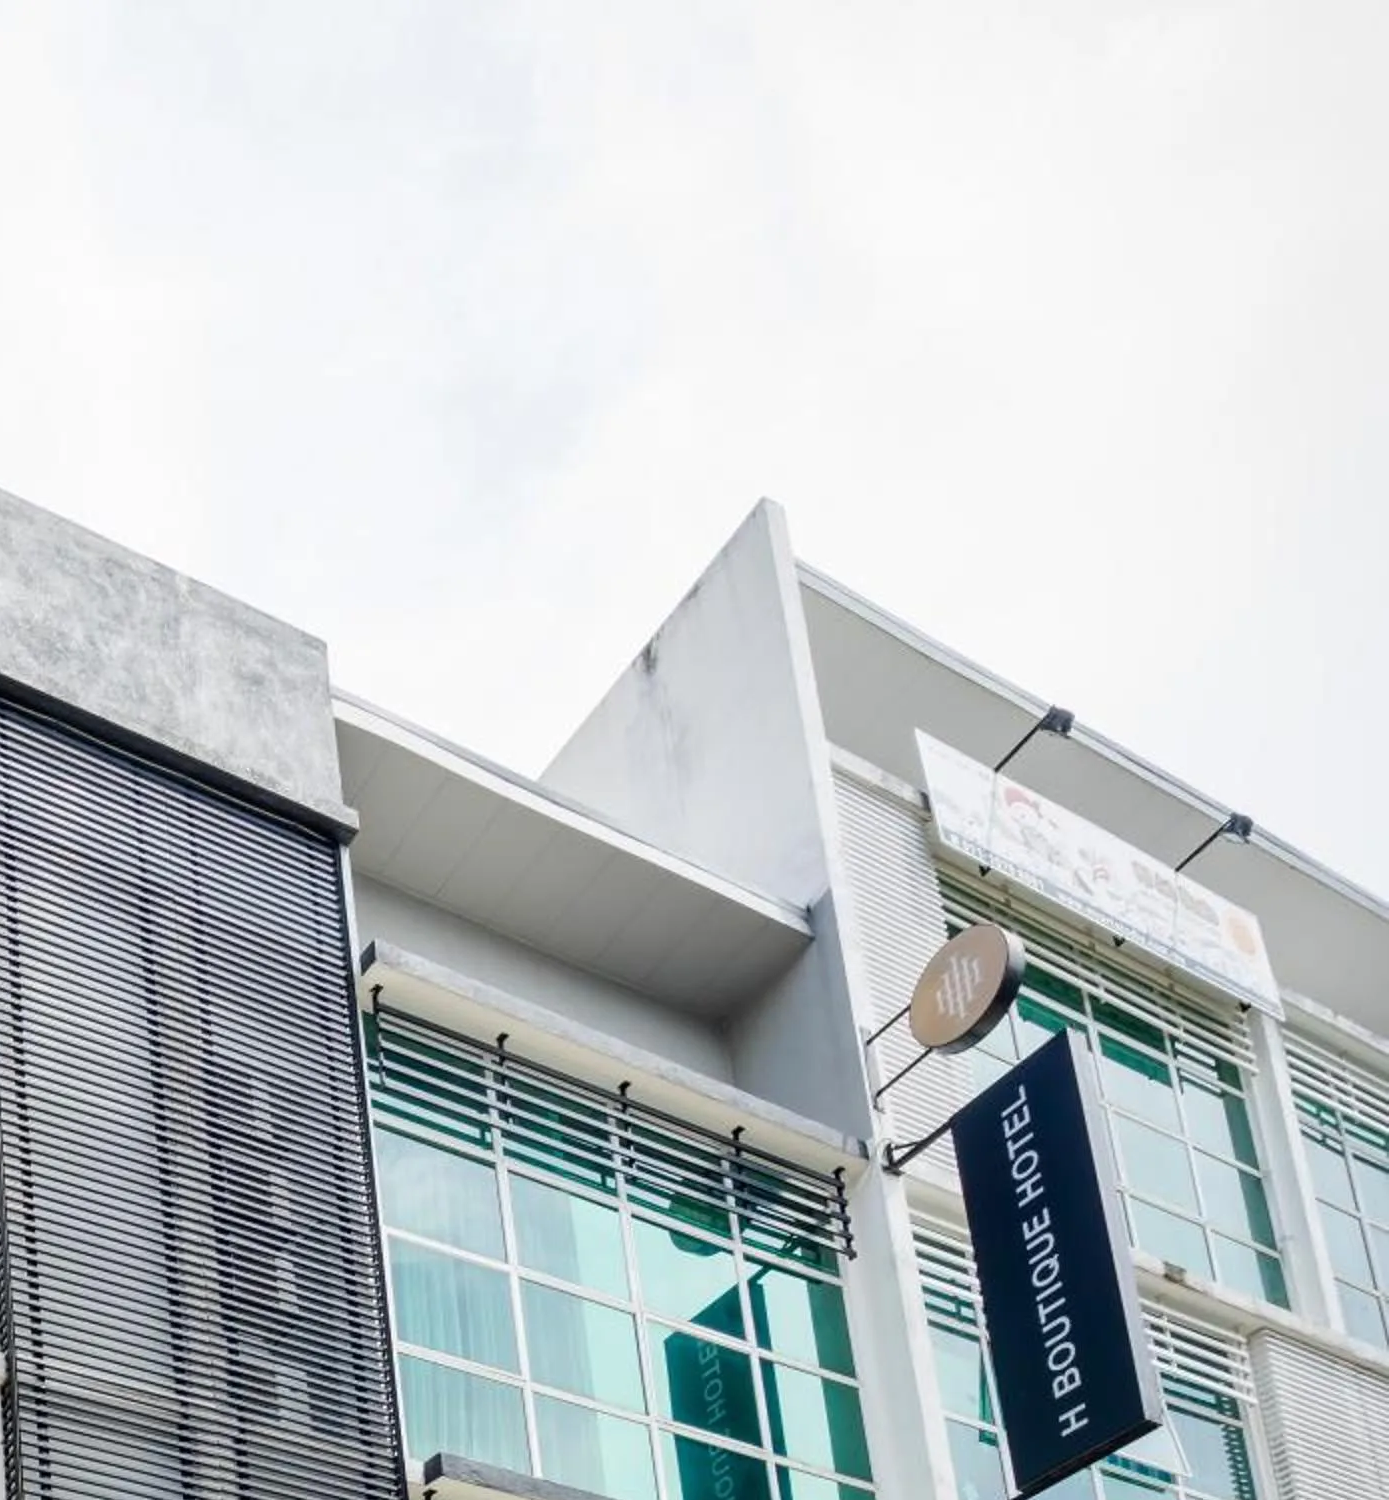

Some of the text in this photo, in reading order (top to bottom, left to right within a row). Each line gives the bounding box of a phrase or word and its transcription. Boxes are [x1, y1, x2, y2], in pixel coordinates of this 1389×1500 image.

[1001, 1084, 1090, 1438] H BOUTIQUE HOTEL
